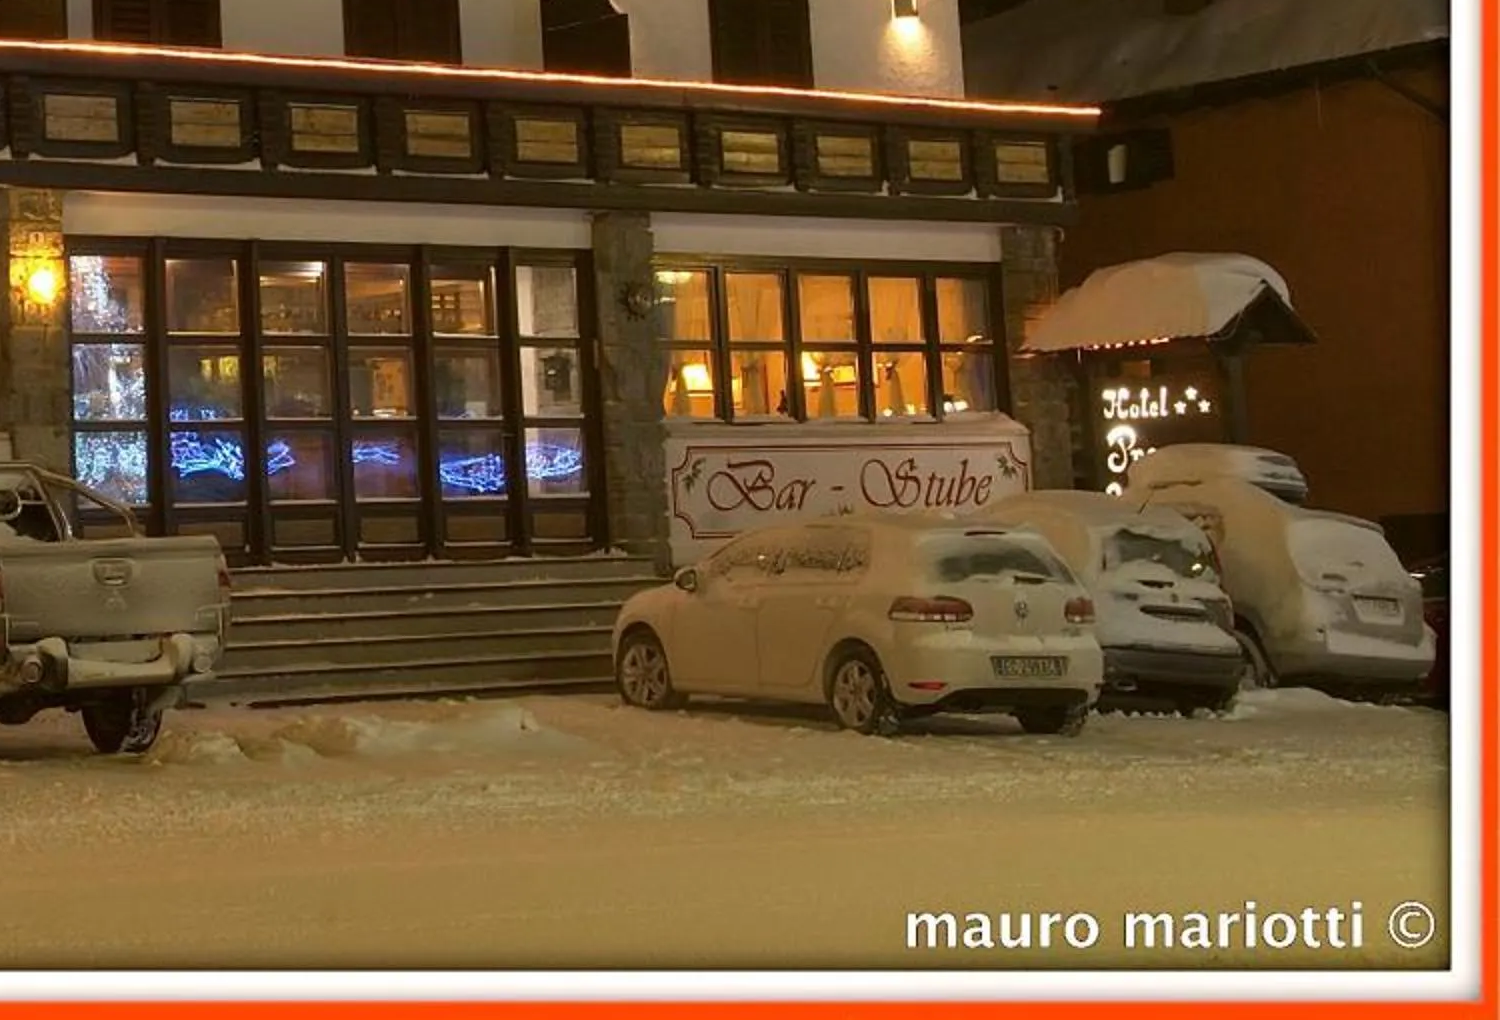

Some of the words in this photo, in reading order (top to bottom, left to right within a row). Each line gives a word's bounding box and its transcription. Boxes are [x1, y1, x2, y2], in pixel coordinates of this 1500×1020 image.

[1102, 385, 1169, 419] Hotel
[707, 459, 816, 511] Bar
[860, 457, 992, 508] Stube
